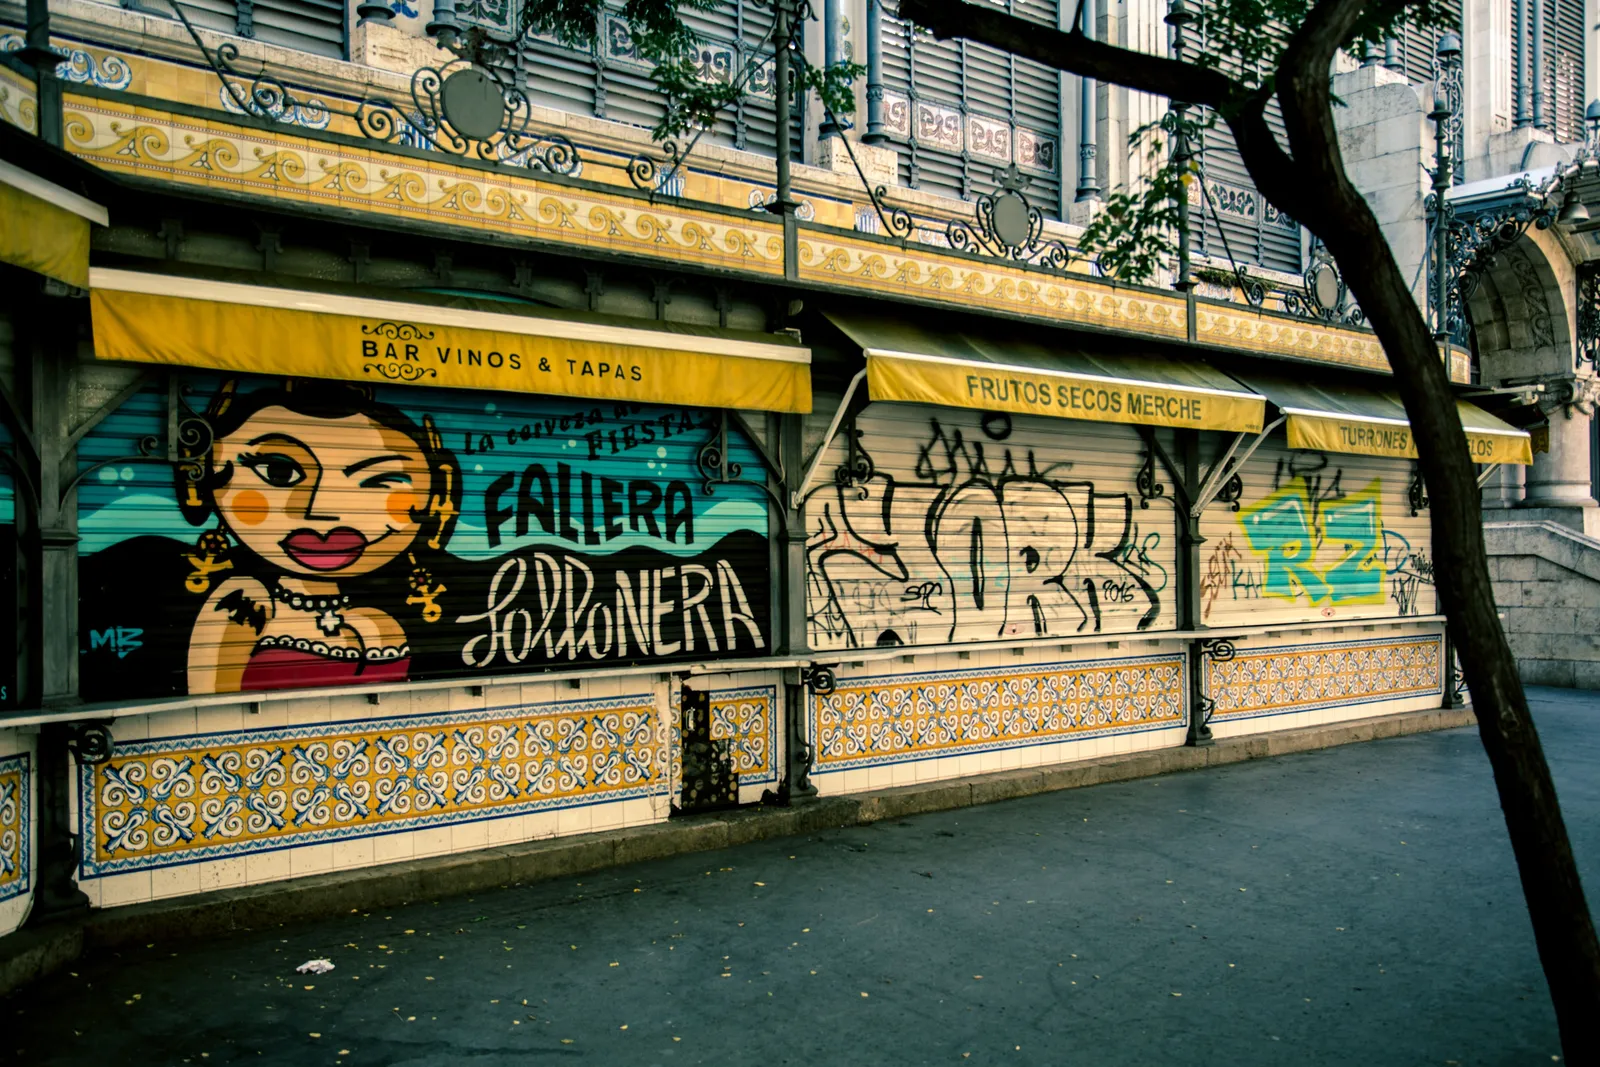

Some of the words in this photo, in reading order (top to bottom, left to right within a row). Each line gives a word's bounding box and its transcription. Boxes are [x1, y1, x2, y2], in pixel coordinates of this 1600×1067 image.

[362, 340, 419, 361] BAR
[437, 347, 521, 370] VINOS
[538, 357, 552, 373] &
[567, 359, 642, 382] TAPAS
[966, 375, 1051, 406] FRUTOS
[1058, 385, 1122, 413] SECOS
[1127, 393, 1202, 420] MERCHE
[584, 407, 697, 461] FIESTA
[1340, 426, 1408, 450] TURRONES
[484, 461, 694, 549] FALLERA
